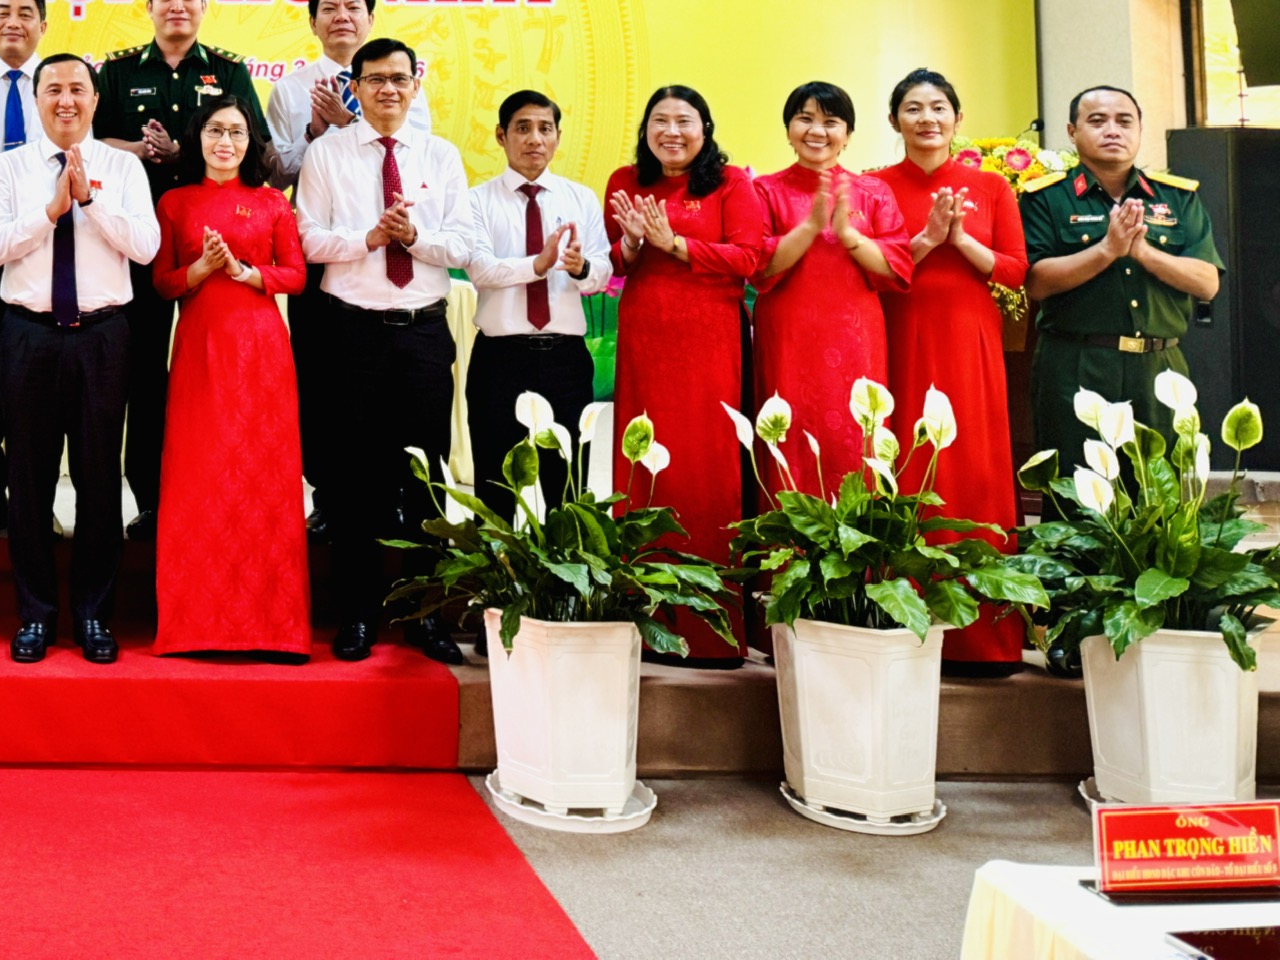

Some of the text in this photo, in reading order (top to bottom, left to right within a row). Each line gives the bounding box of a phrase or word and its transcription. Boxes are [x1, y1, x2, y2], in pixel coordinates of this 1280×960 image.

[1175, 814, 1209, 828] ÔNG
[1113, 827, 1272, 860] PHAN TRỌNG HIỀN
